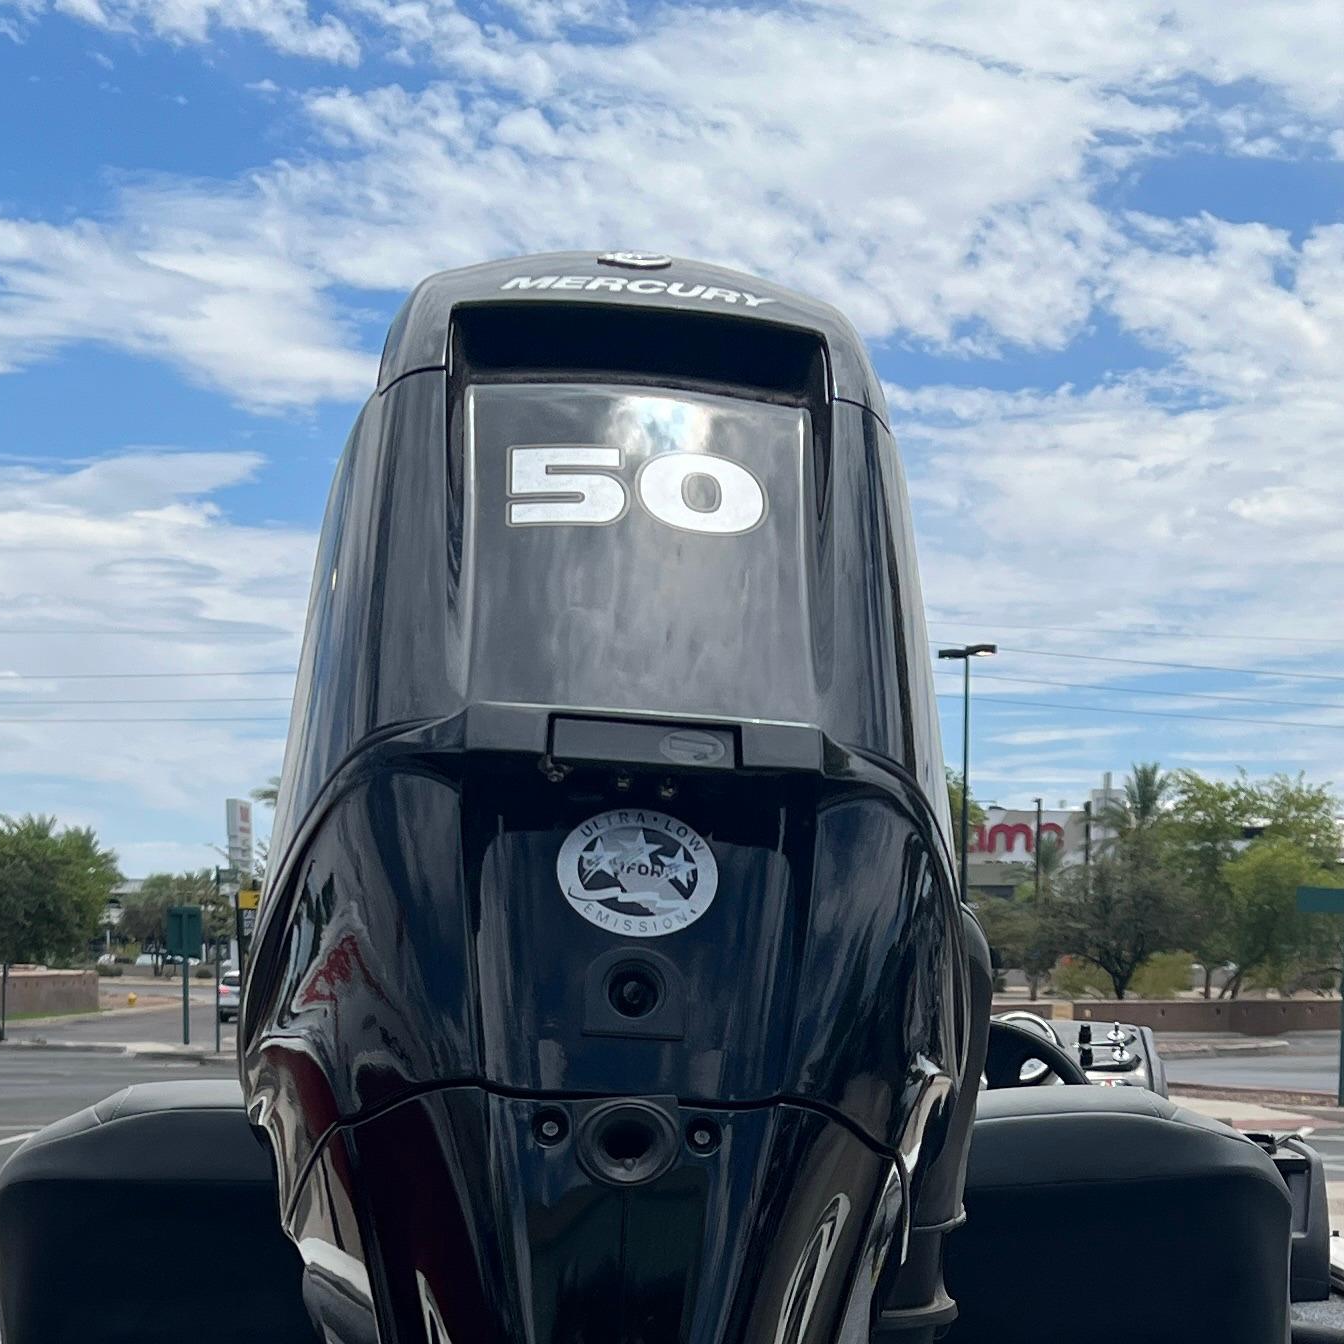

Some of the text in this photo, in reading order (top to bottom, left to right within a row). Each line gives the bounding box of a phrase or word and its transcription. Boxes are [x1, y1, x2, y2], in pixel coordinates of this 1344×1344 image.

[501, 276, 777, 307] MERCURY
[507, 445, 769, 536] 50
[580, 811, 705, 852] ULTRA LOW
[583, 903, 688, 933] EMISSION
